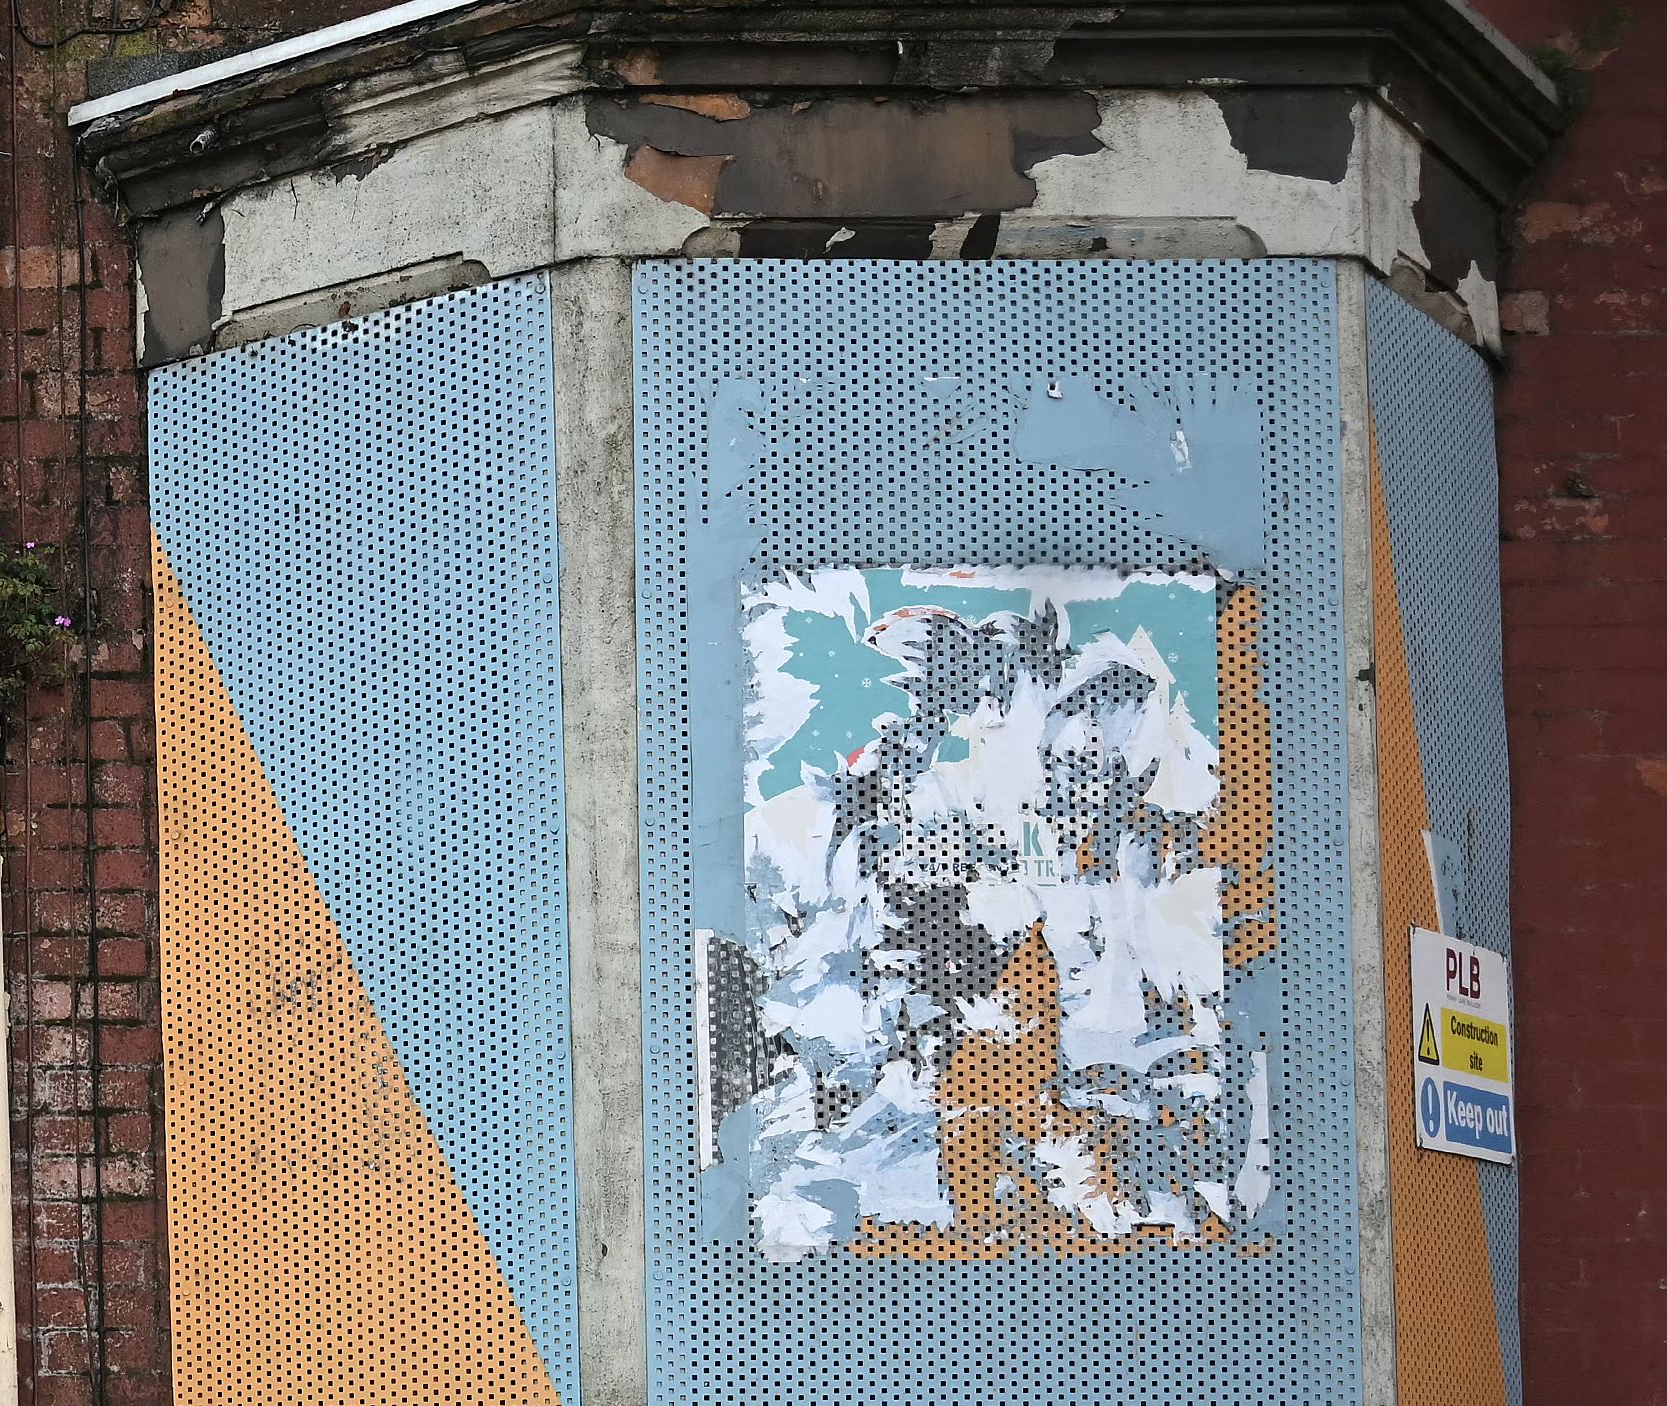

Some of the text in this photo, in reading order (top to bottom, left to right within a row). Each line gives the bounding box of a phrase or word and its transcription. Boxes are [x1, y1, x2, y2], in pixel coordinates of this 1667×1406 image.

[1445, 947, 1481, 1000] PLB
[1450, 1015, 1499, 1047] Construction
[1469, 1051, 1484, 1071] site
[1447, 1089, 1508, 1139] Keep out
